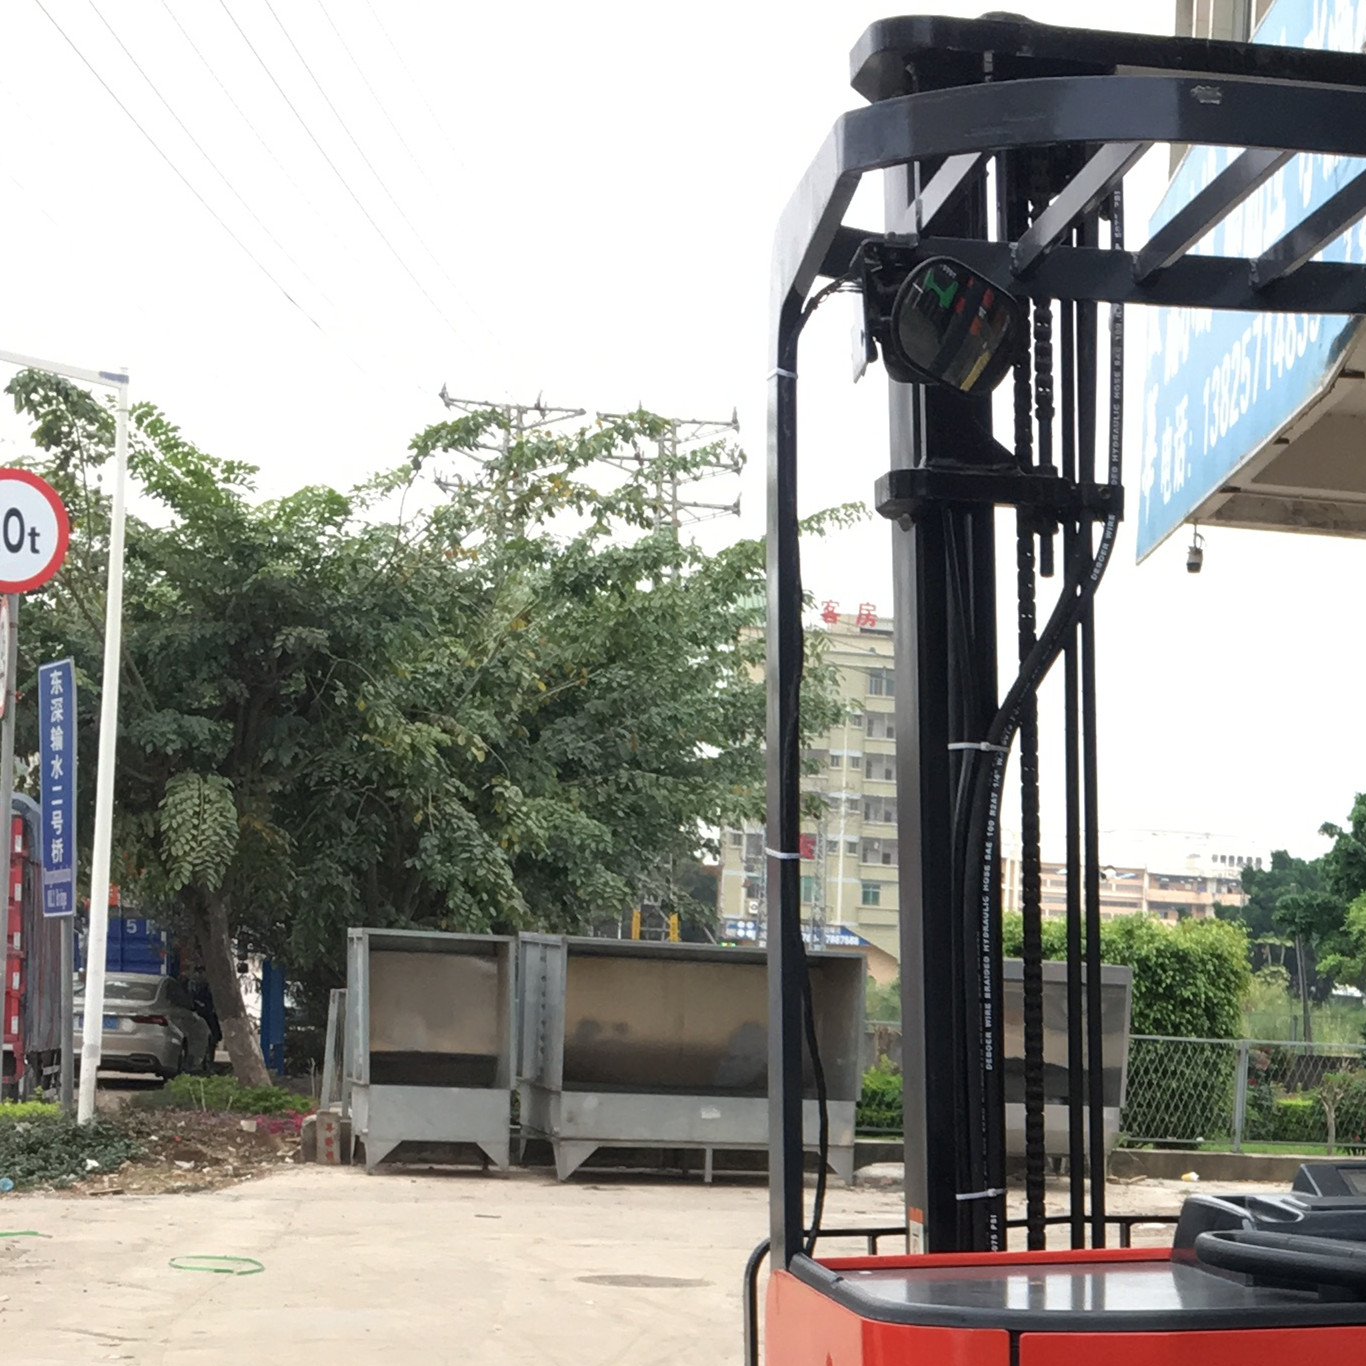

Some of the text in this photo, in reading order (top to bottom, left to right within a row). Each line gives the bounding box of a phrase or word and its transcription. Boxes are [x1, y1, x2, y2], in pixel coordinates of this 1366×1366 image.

[1104, 514, 1115, 539] WIRE
[1111, 403, 1120, 462] HYDRAULIC
[821, 600, 878, 627] 客房
[49, 669, 64, 864] 东深输水二号桥
[981, 895, 991, 952] HYDRAULIC
[983, 955, 992, 999] BRAIDED
[984, 1003, 993, 1028] WIRE
